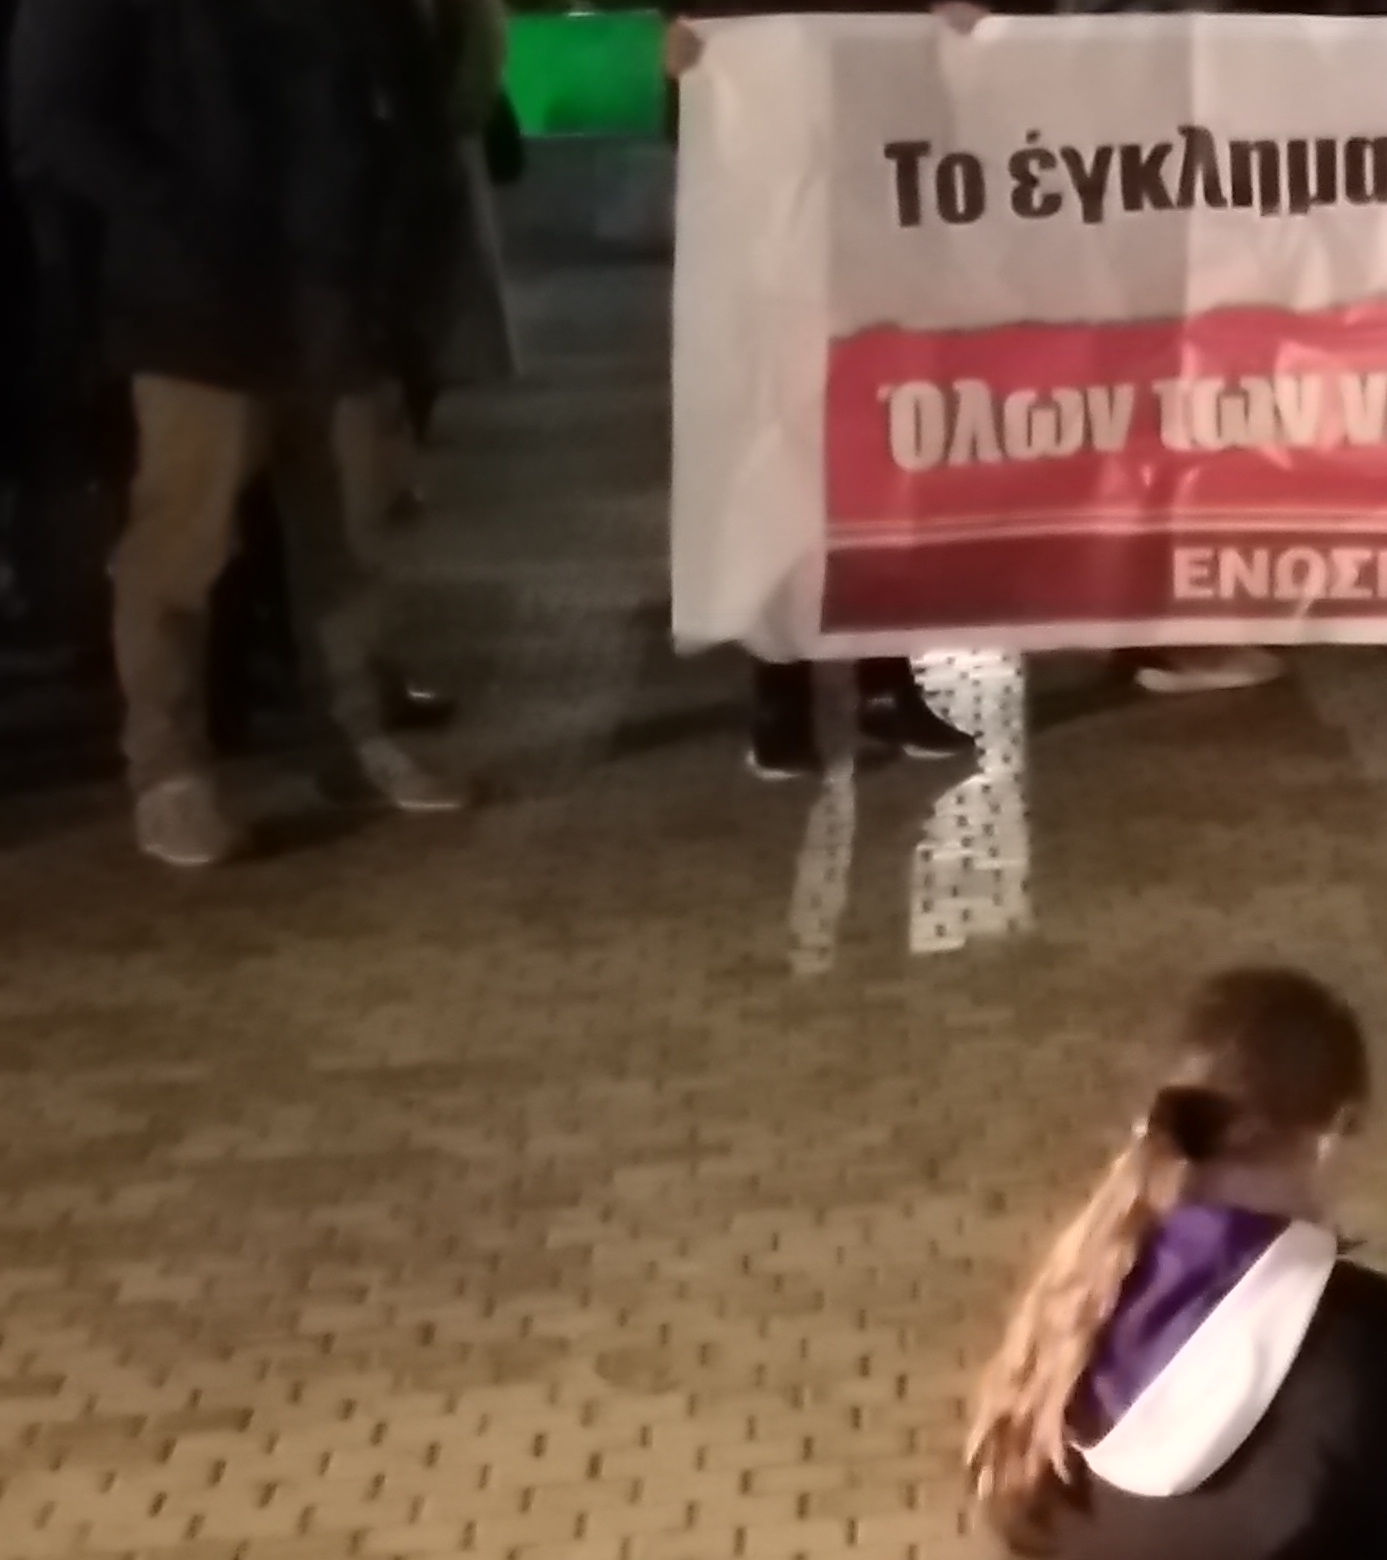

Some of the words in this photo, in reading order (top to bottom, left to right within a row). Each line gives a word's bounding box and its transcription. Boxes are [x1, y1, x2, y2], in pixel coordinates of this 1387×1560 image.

[884, 139, 987, 228] Το
[877, 377, 1136, 474] Όλων
[1153, 370, 1325, 455] των
